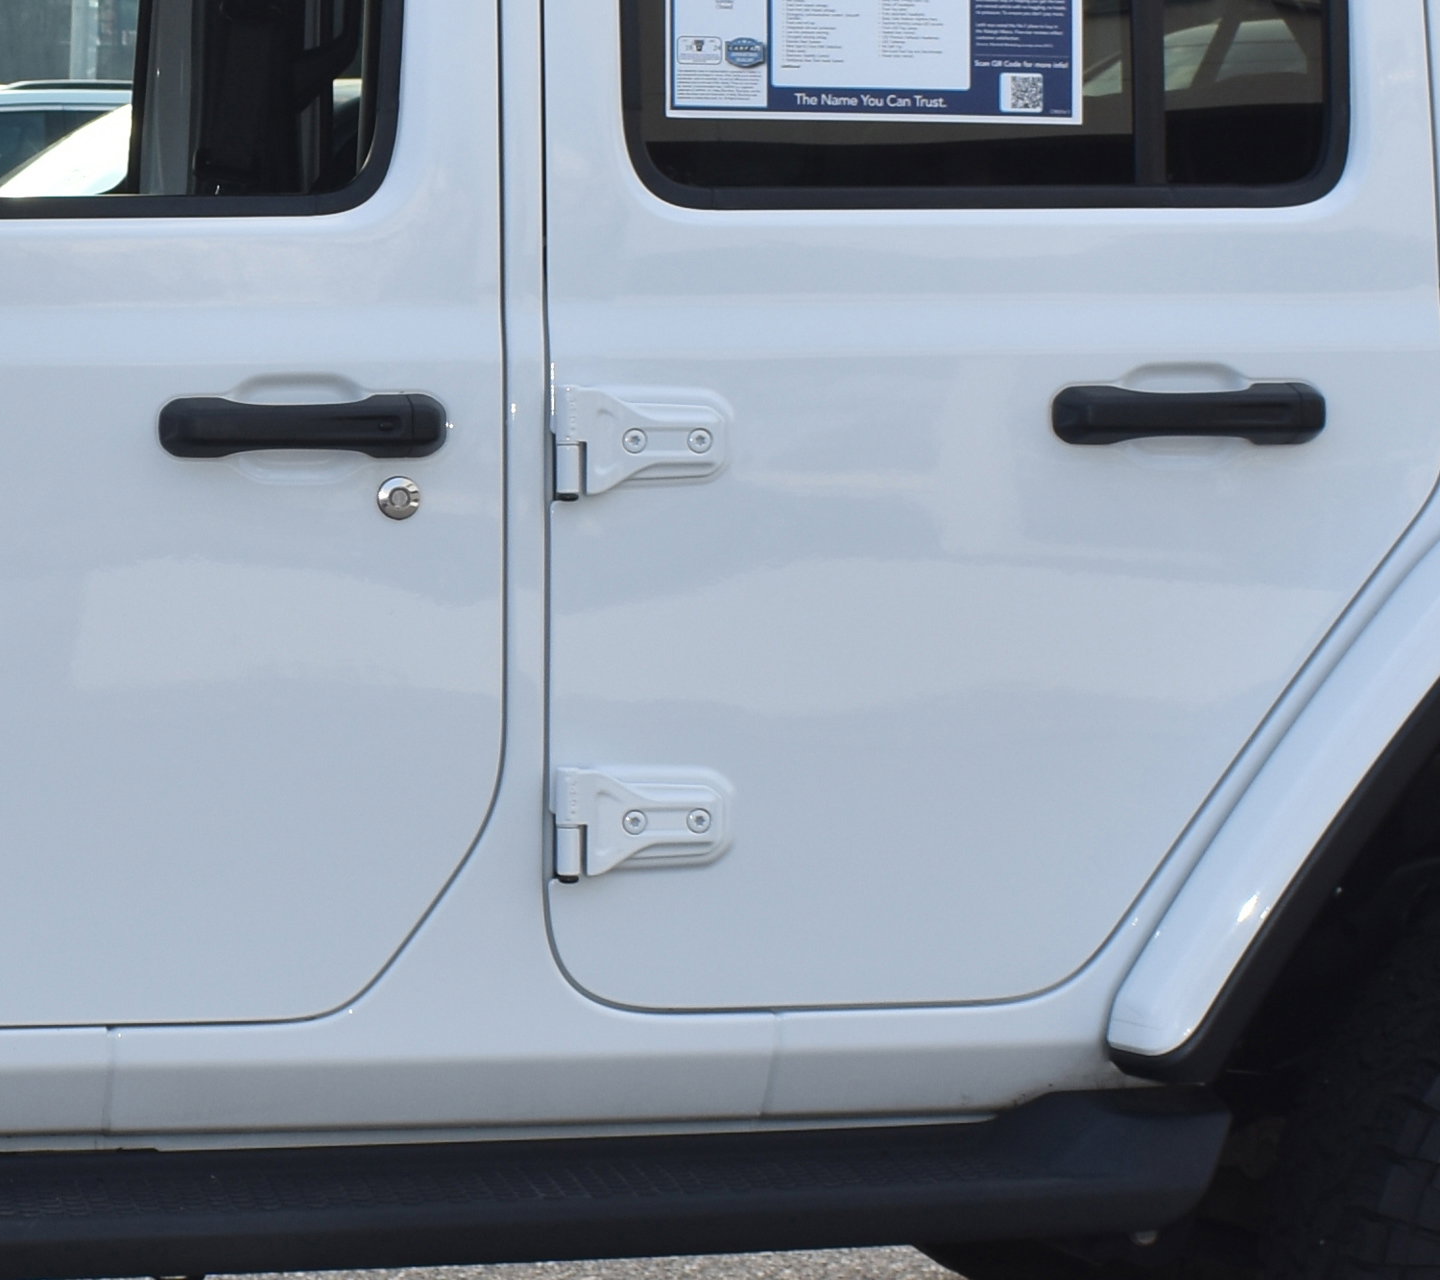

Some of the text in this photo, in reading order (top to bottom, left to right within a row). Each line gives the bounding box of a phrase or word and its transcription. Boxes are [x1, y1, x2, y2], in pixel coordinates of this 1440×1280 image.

[794, 92, 948, 109] The Name You Can Trust.
